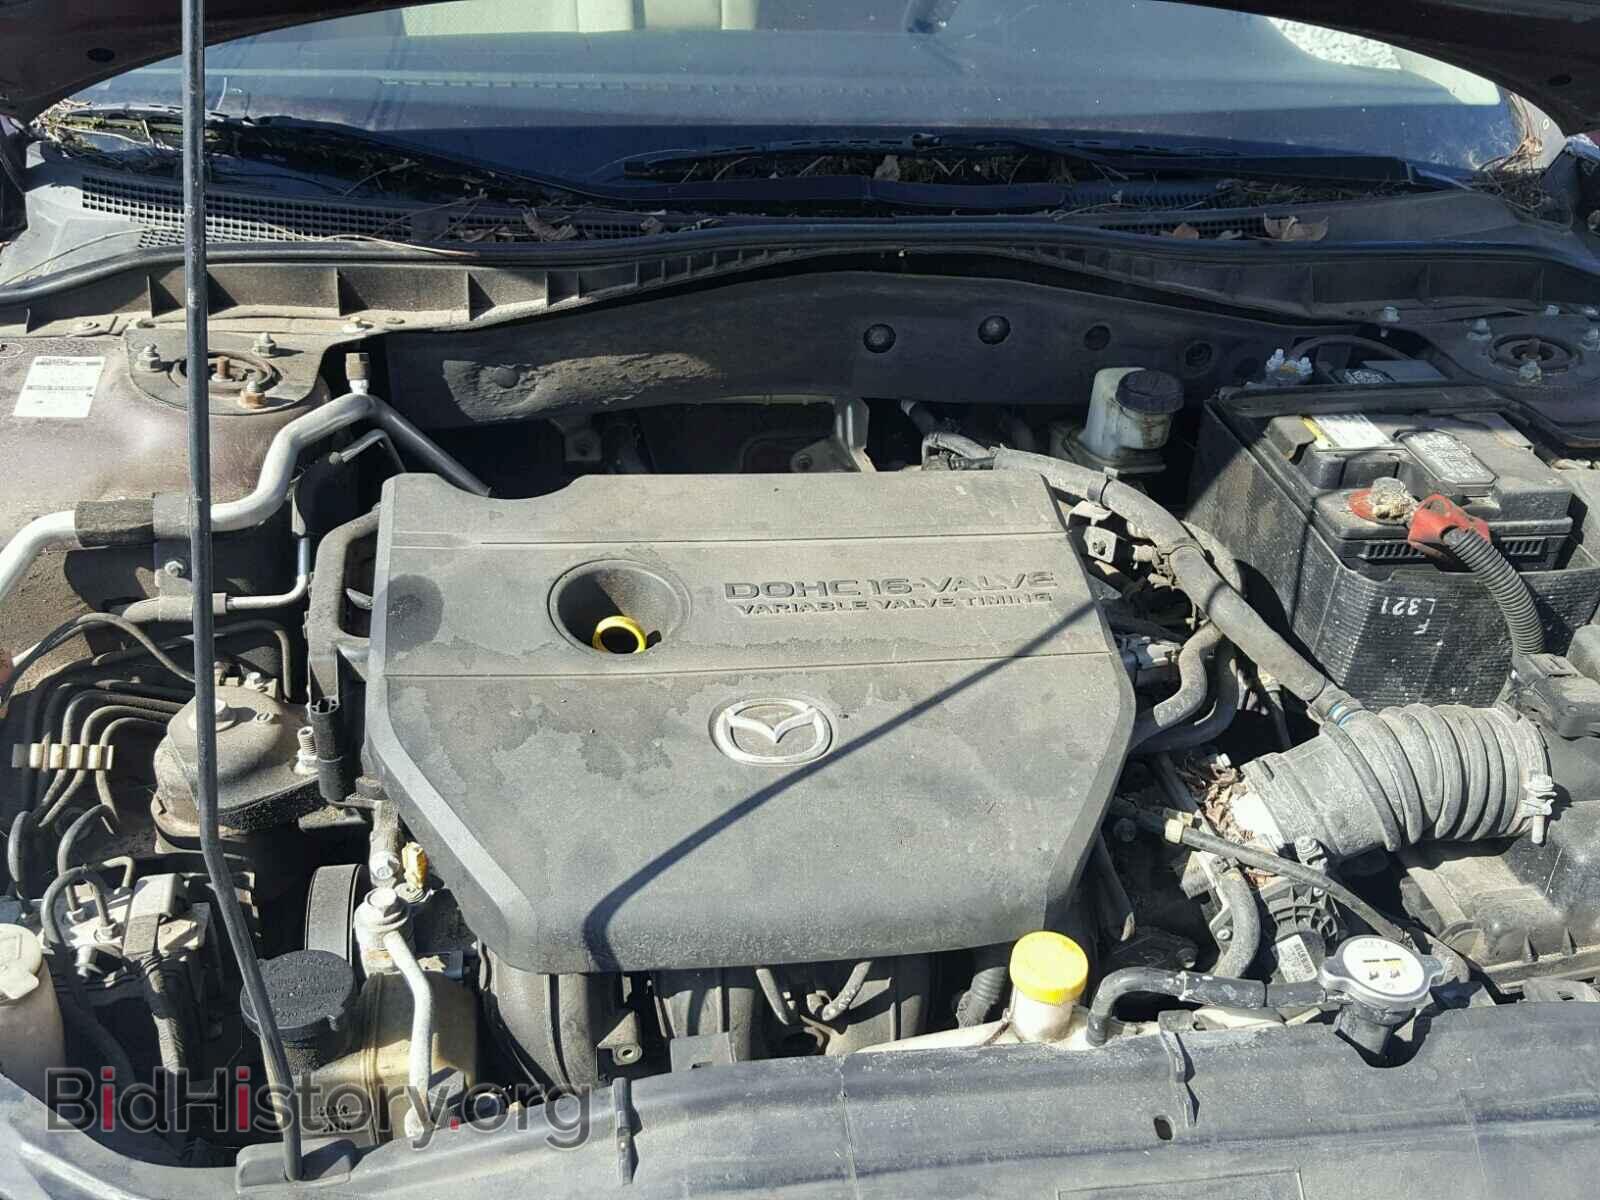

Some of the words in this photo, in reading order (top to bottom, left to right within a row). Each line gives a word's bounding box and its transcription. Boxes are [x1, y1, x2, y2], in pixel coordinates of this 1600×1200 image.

[724, 580, 862, 600] DOHC
[866, 571, 1058, 596] 16-VALVE
[734, 600, 870, 615] VARIABLE
[873, 597, 957, 610] VALVE
[964, 592, 1053, 606] TIMING
